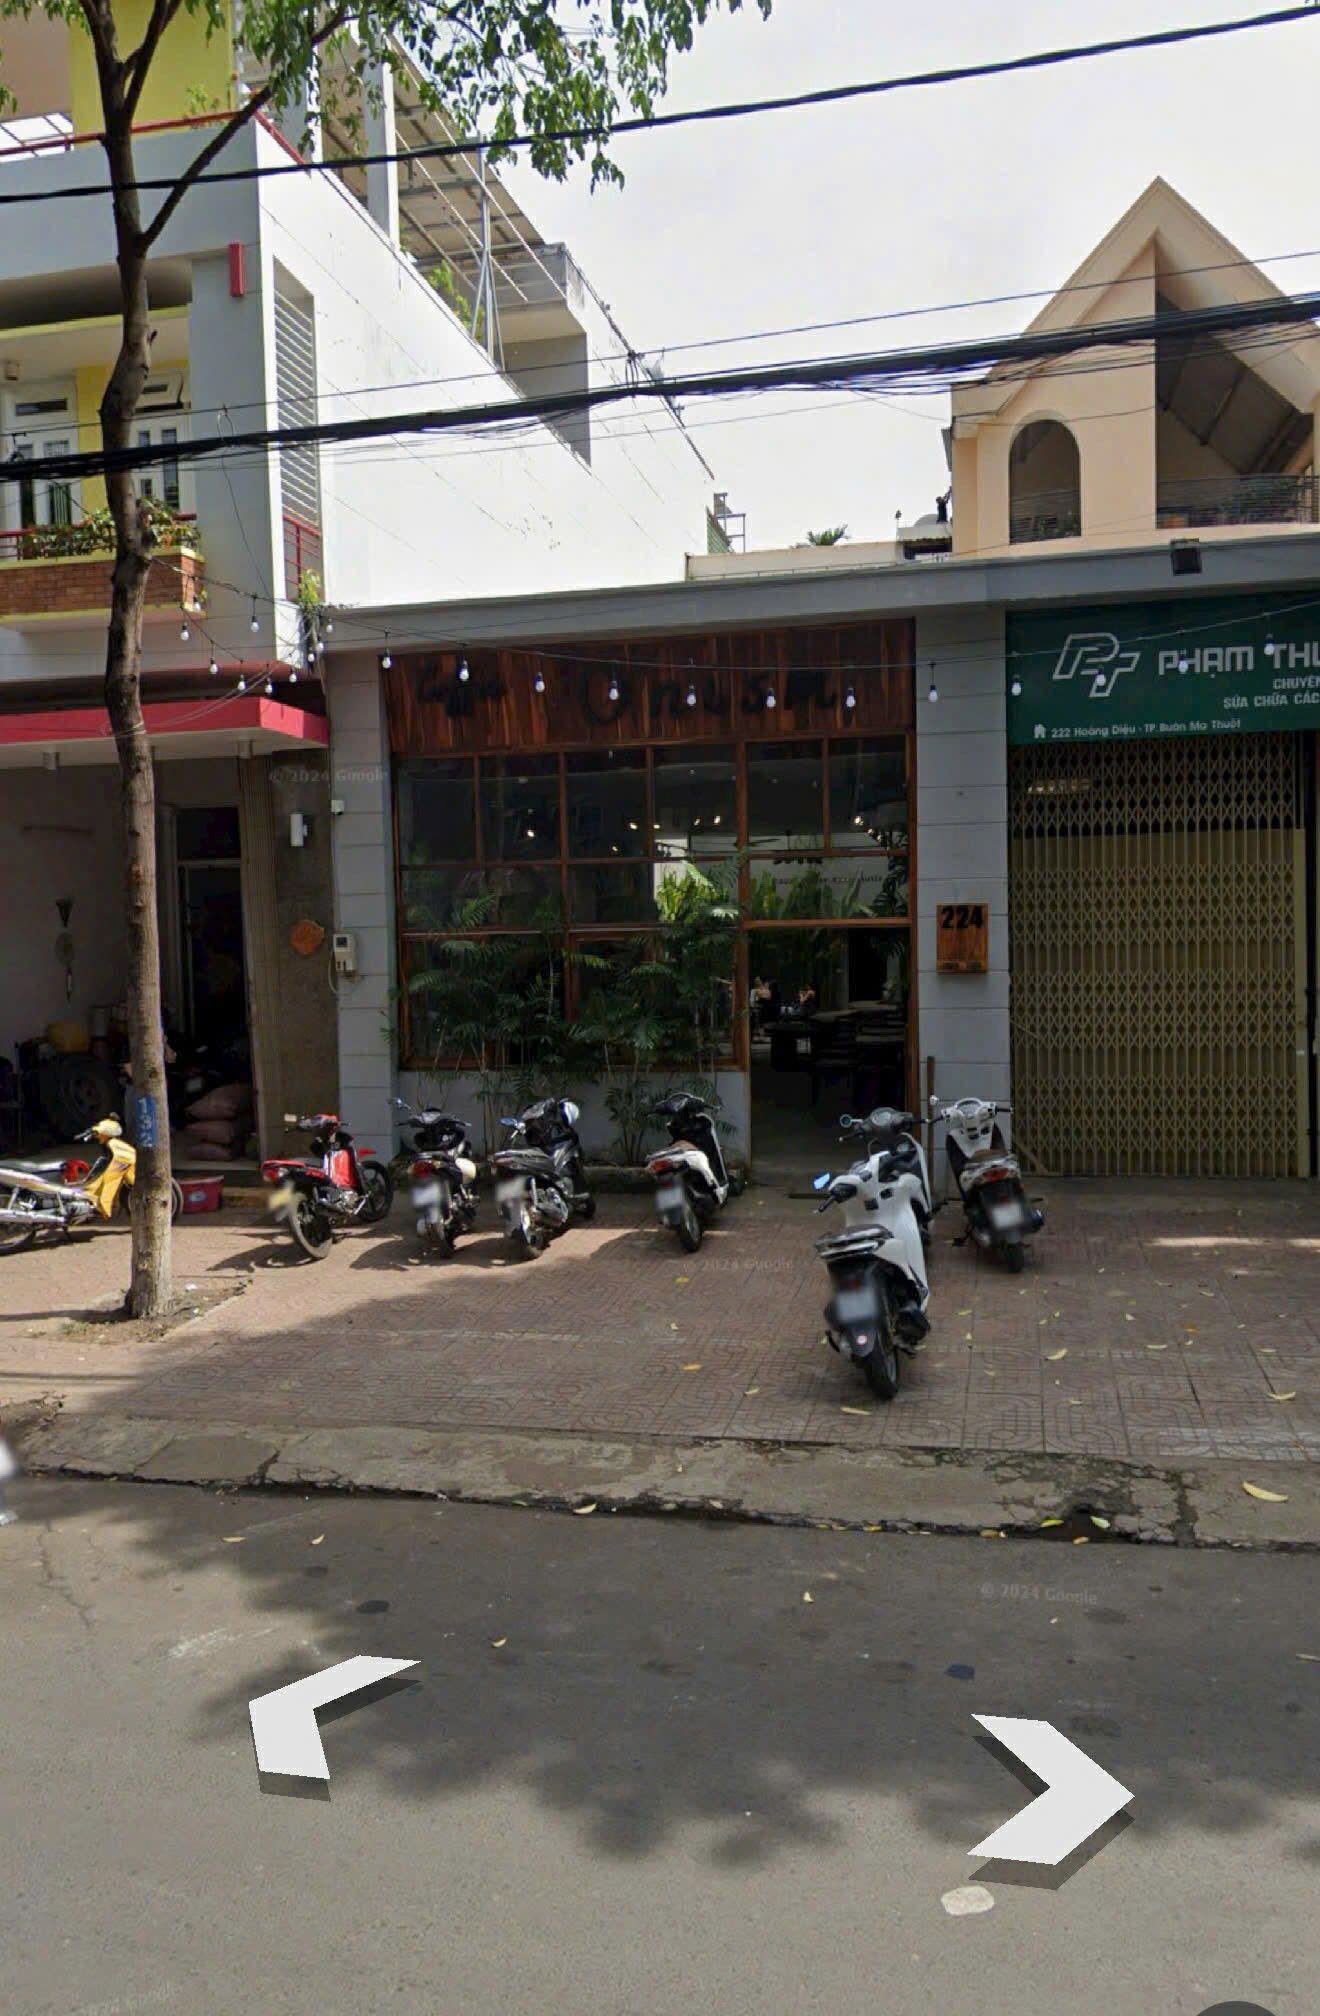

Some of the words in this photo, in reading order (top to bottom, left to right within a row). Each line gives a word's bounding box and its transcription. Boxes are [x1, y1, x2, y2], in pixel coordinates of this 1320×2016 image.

[1158, 647, 1254, 678] PHẠM
[1051, 728, 1071, 739] 222
[941, 904, 984, 929] 224
